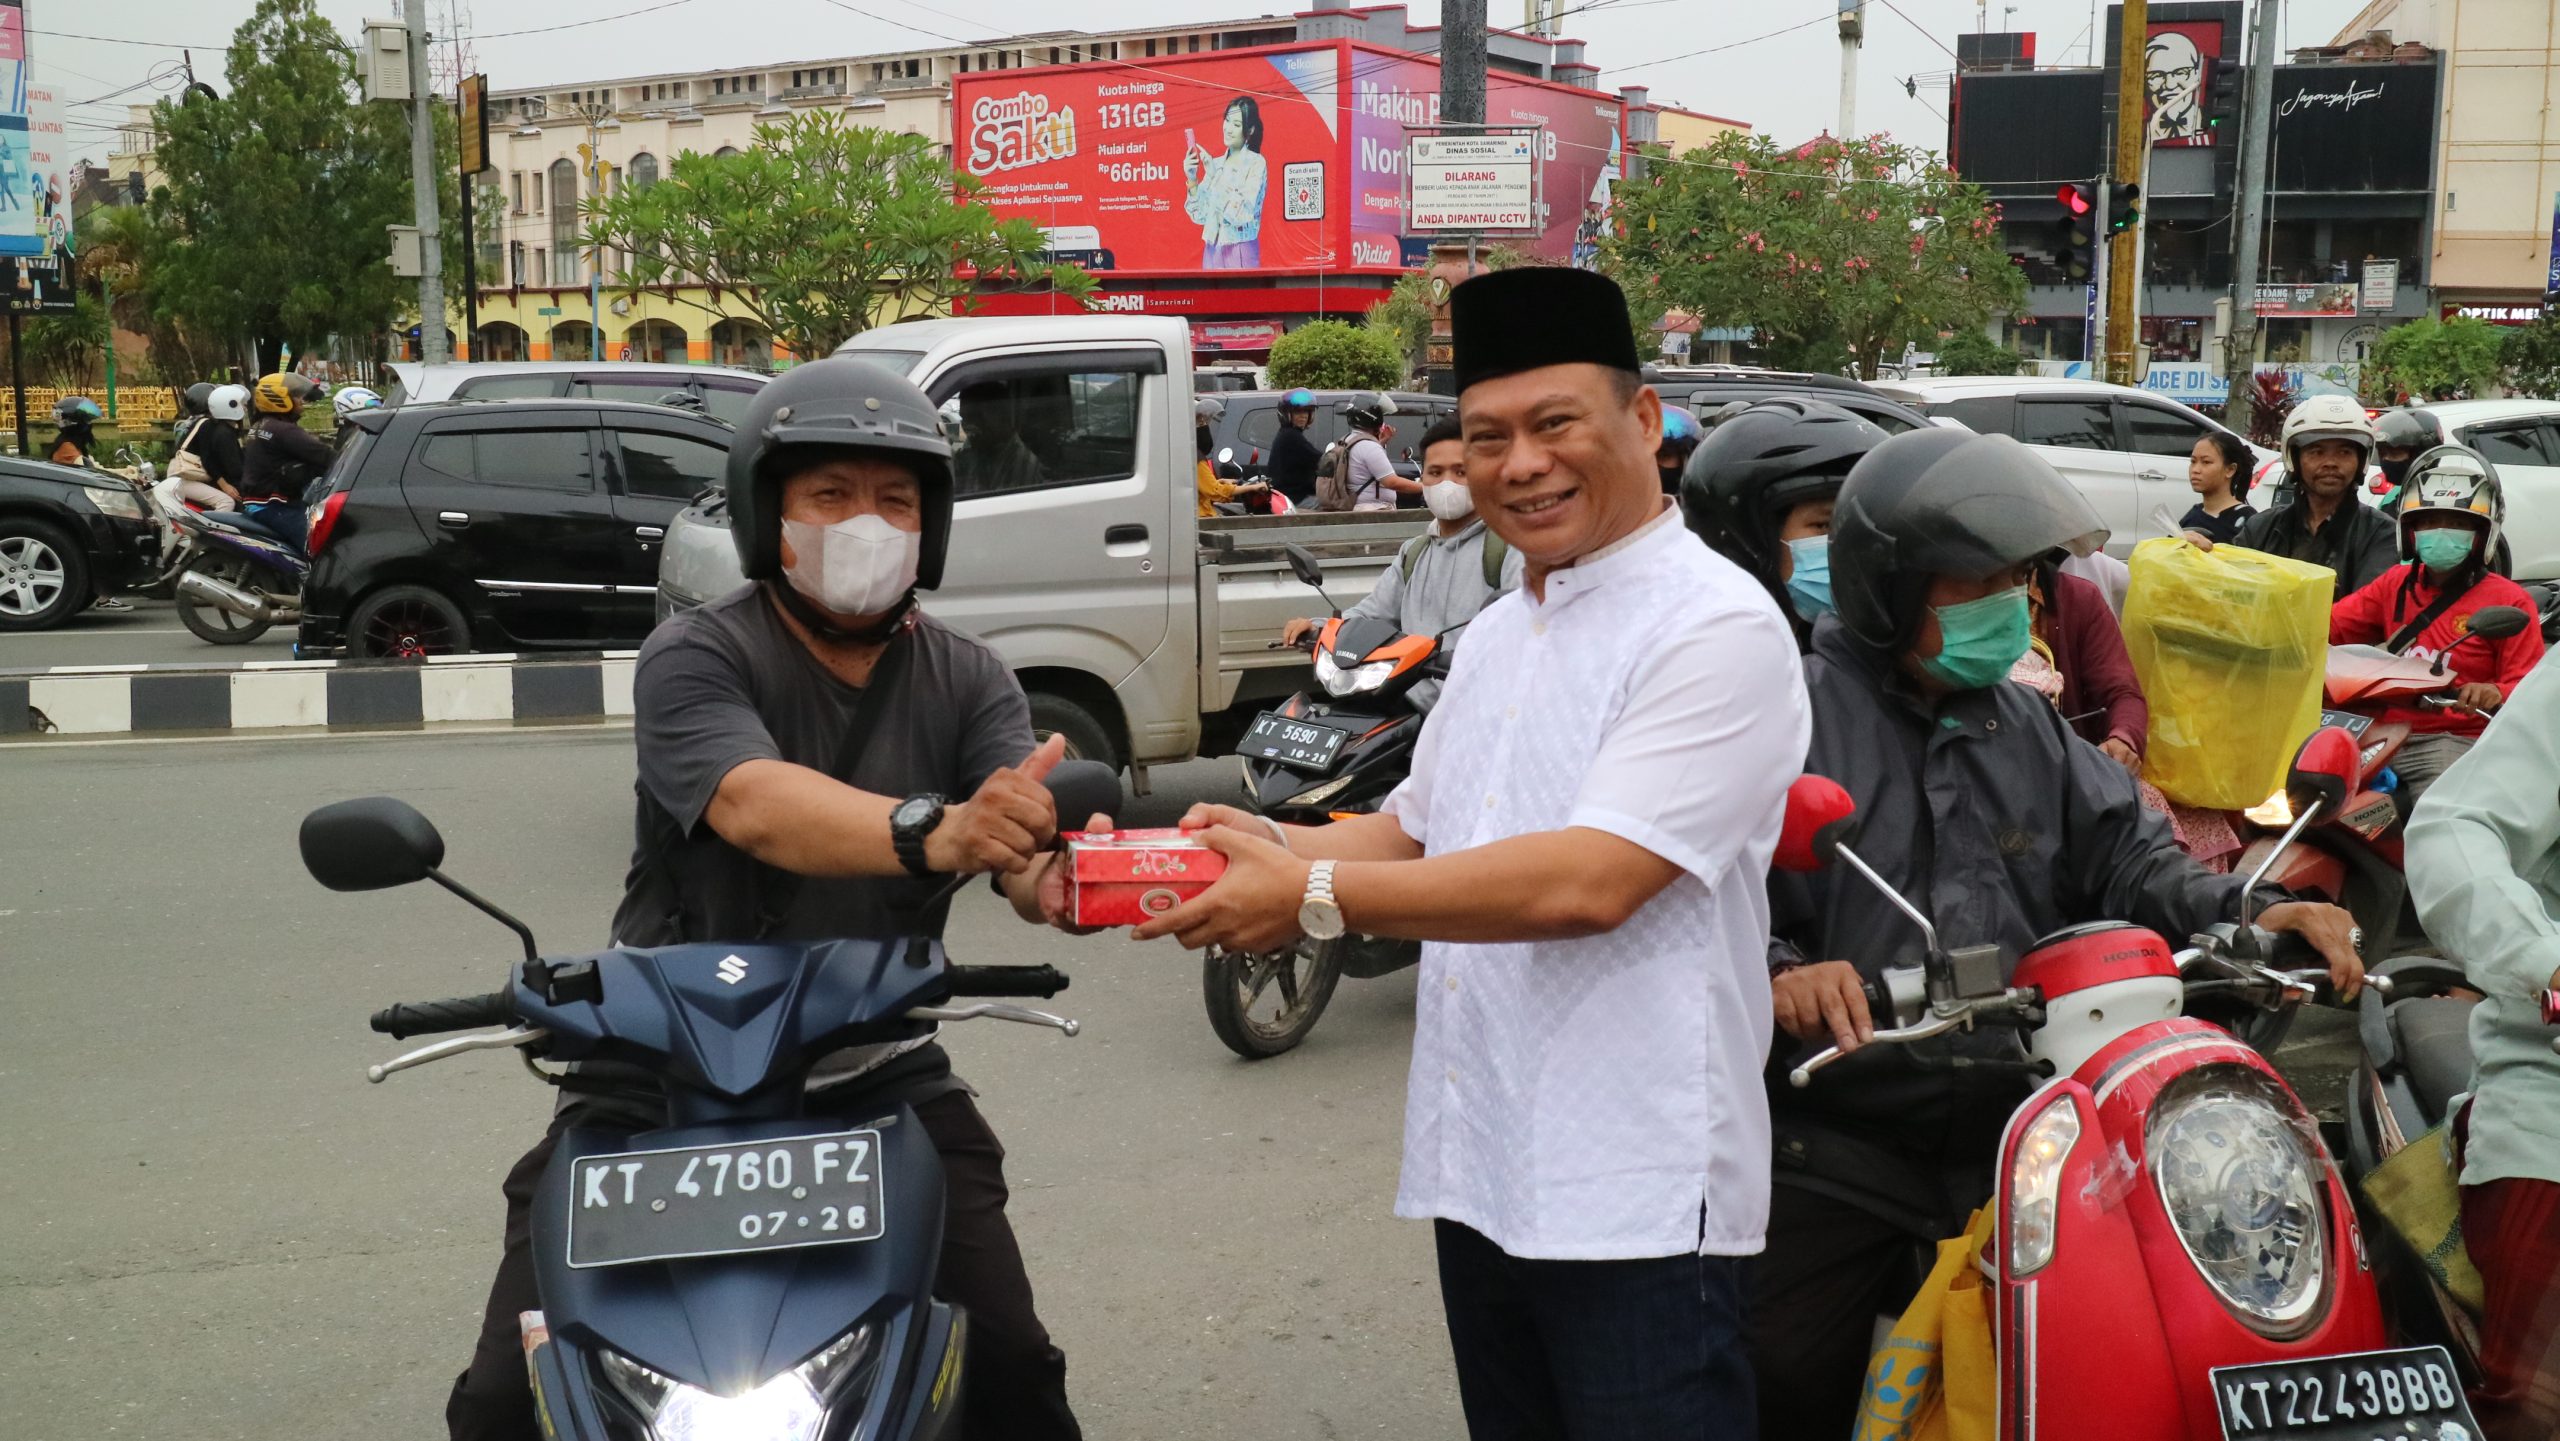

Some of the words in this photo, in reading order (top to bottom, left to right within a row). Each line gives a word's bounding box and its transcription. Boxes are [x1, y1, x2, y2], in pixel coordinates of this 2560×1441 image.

[27, 90, 52, 101] MATAN
[1098, 84, 1128, 96] Kuota
[1130, 82, 1164, 95] hingga
[976, 95, 1045, 122] Combo
[1361, 79, 1424, 125] Makin
[28, 105, 33, 115] A
[1098, 102, 1166, 129] 131GB
[1511, 109, 1527, 120] Kuota
[28, 122, 36, 131] LU
[38, 123, 63, 134] LINTAS
[972, 111, 1073, 171] Sakti
[1098, 143, 1125, 156] Mulai
[1126, 141, 1147, 154] dari
[30, 152, 50, 163] ATAN
[1098, 163, 1109, 174] Rp
[1110, 161, 1169, 182] 66ribu
[1303, 166, 1308, 174] di
[1445, 171, 1496, 182] DILARANG
[1020, 183, 1054, 192] Untukmu
[1054, 181, 1068, 190] dan
[991, 197, 1012, 205] Akses
[1013, 195, 1042, 207] Aplikasi
[1364, 192, 1393, 210] Dengan
[1417, 214, 1444, 224] ANDA
[1447, 214, 1497, 224] DIPANTAU
[1499, 213, 1526, 223] CCTV
[1353, 240, 1392, 265] Vidio
[2458, 308, 2508, 319] OPTIK
[2186, 371, 2205, 390] DI
[1336, 650, 1357, 660] YAMAHA
[1255, 720, 1278, 736] KT
[1282, 725, 1318, 745] 5690
[1325, 734, 1339, 749] N
[2354, 802, 2390, 822] HONDA
[2103, 949, 2160, 963] HONDA
[584, 1162, 643, 1209] KT
[675, 1149, 792, 1198] 4760
[813, 1141, 871, 1185] FZ
